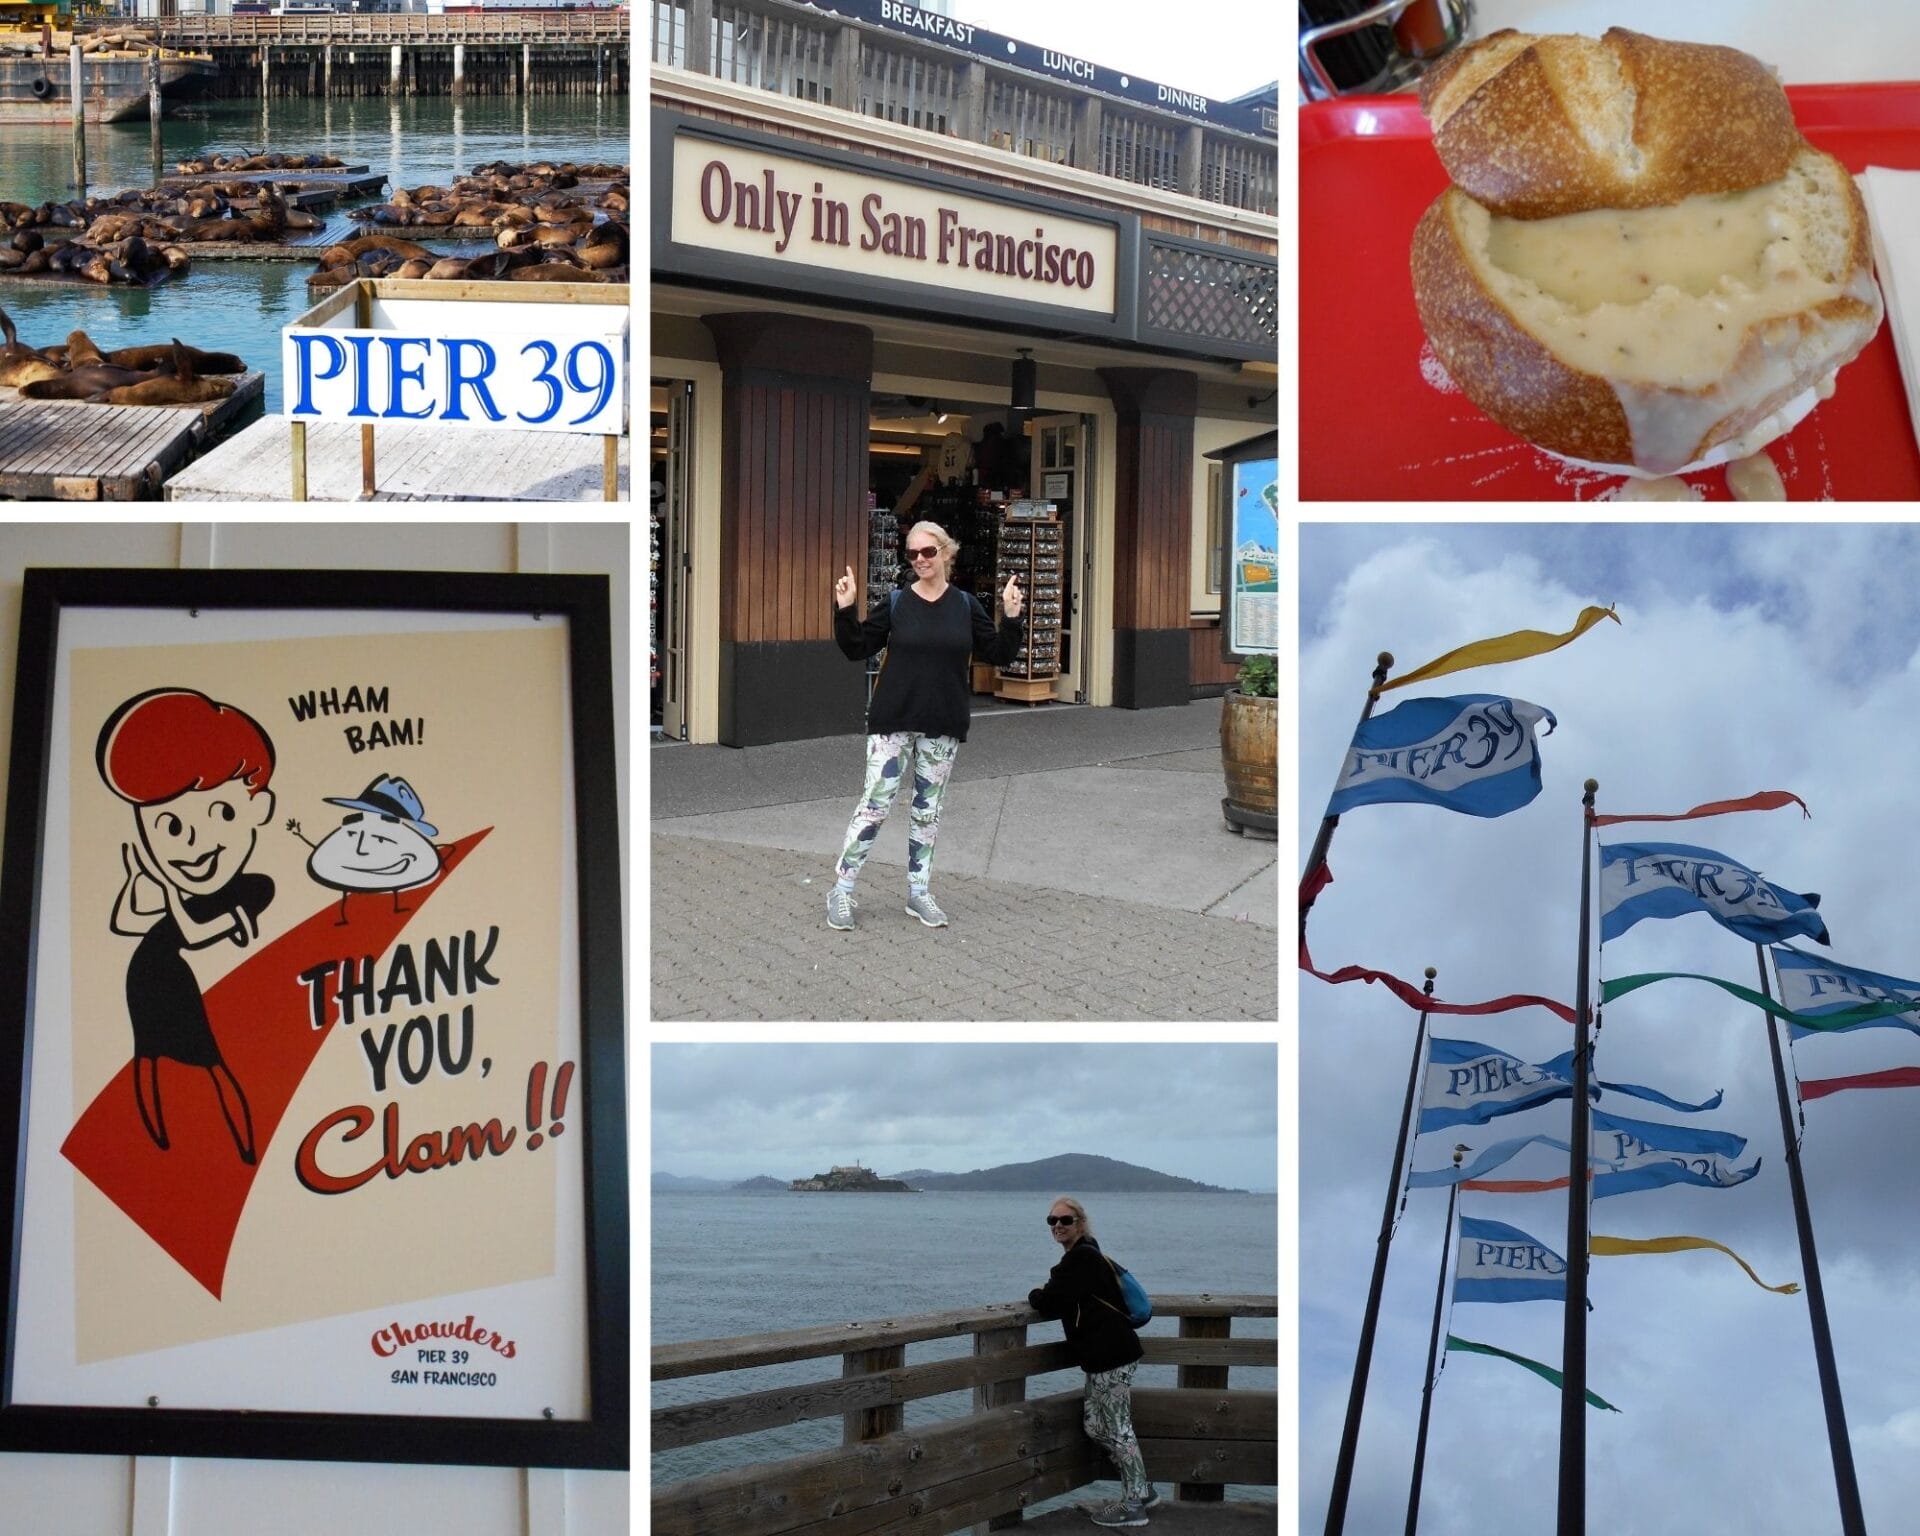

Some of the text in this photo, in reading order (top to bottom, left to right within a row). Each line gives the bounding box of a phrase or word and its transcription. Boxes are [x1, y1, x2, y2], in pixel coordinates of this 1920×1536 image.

[881, 0, 1208, 114] BREAKFAST LUNCH DINNER
[700, 159, 1095, 290] Only in San Francisco
[289, 334, 616, 426] PIER 39
[288, 685, 389, 722] WHAM
[343, 717, 425, 755] BAM!
[298, 925, 501, 1029] THANK
[360, 1003, 493, 1092] YOU,
[294, 1061, 576, 1195] Clam!!
[1475, 1241, 1549, 1273] PIER
[371, 1315, 517, 1359] Chowders
[417, 1349, 470, 1364] PIER 39
[390, 1370, 497, 1387] SAN FRANCISCO
